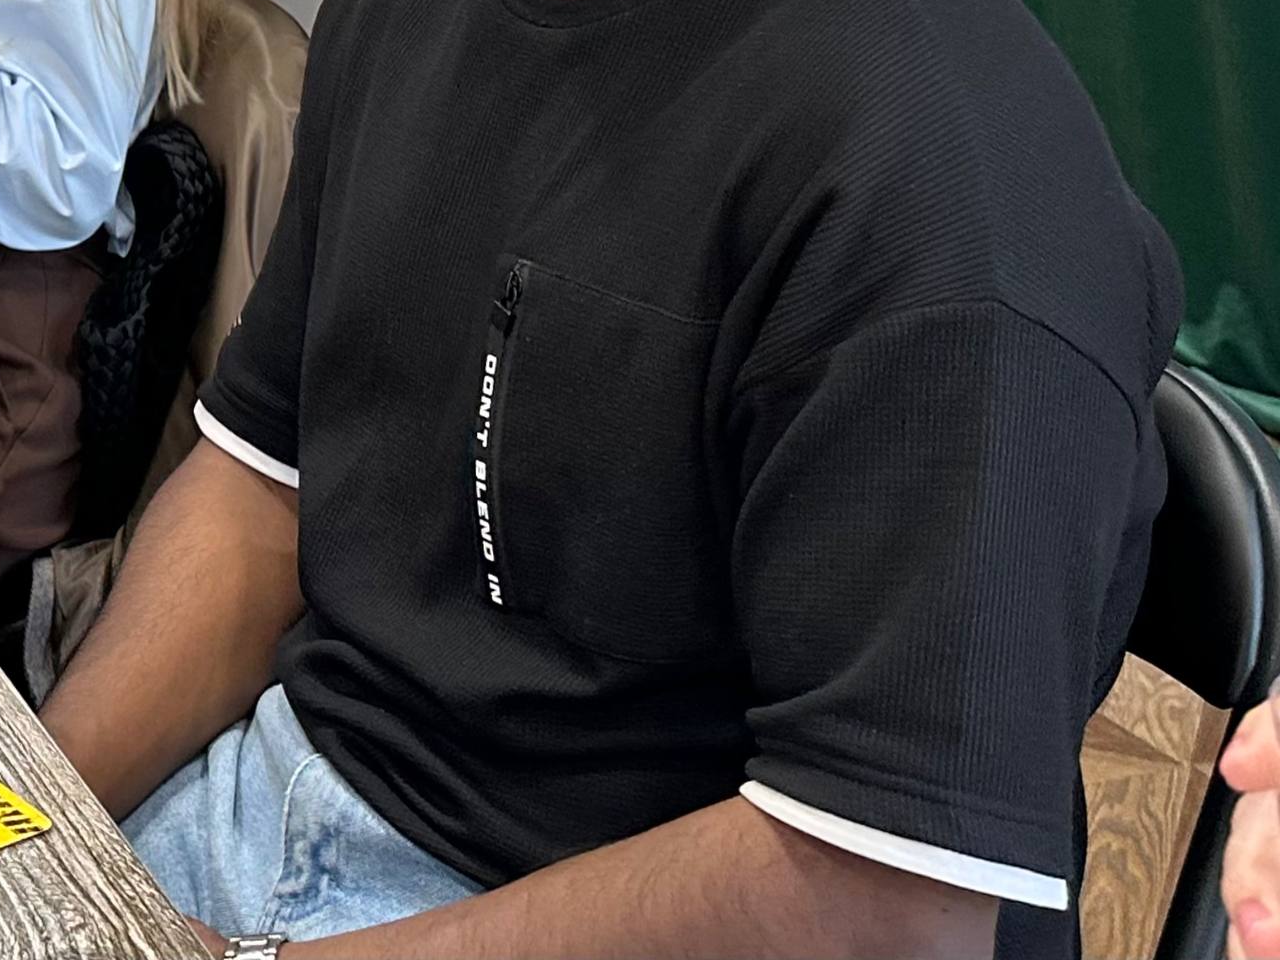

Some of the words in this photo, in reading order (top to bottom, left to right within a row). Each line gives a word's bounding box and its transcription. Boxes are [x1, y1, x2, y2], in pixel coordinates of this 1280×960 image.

[476, 354, 497, 447] DON'T
[475, 460, 495, 562] BLEND
[487, 574, 503, 605] IN
